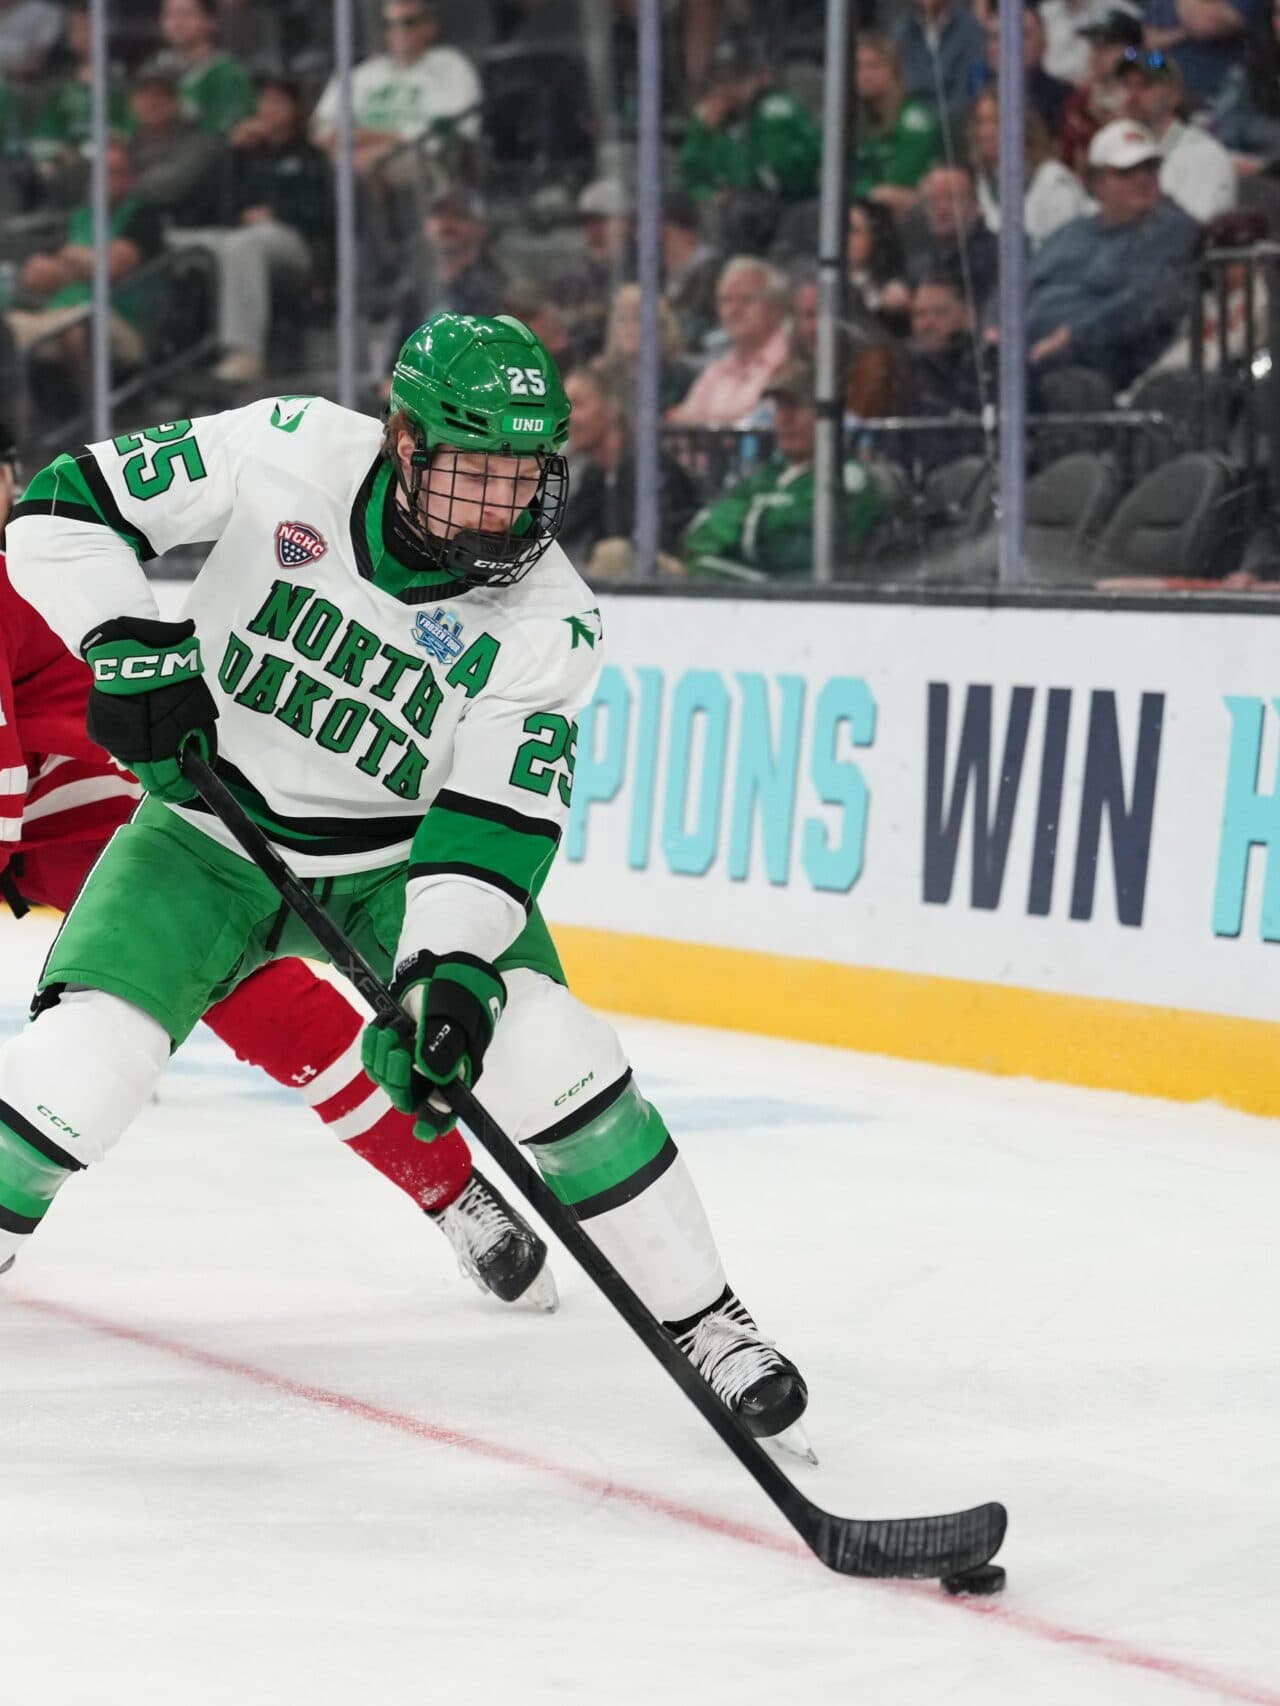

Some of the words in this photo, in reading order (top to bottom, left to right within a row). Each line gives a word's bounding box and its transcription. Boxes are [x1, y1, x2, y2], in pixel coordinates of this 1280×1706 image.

[506, 367, 547, 396] 25
[512, 418, 544, 432] UND
[278, 525, 324, 558] NCHC
[94, 649, 198, 680] CCM
[247, 580, 444, 739] NORTH
[445, 631, 501, 698] A
[218, 631, 429, 800] DAKOTA
[921, 681, 1166, 928] WIN
[554, 1072, 593, 1106] CCM
[37, 1105, 80, 1138] CCM
